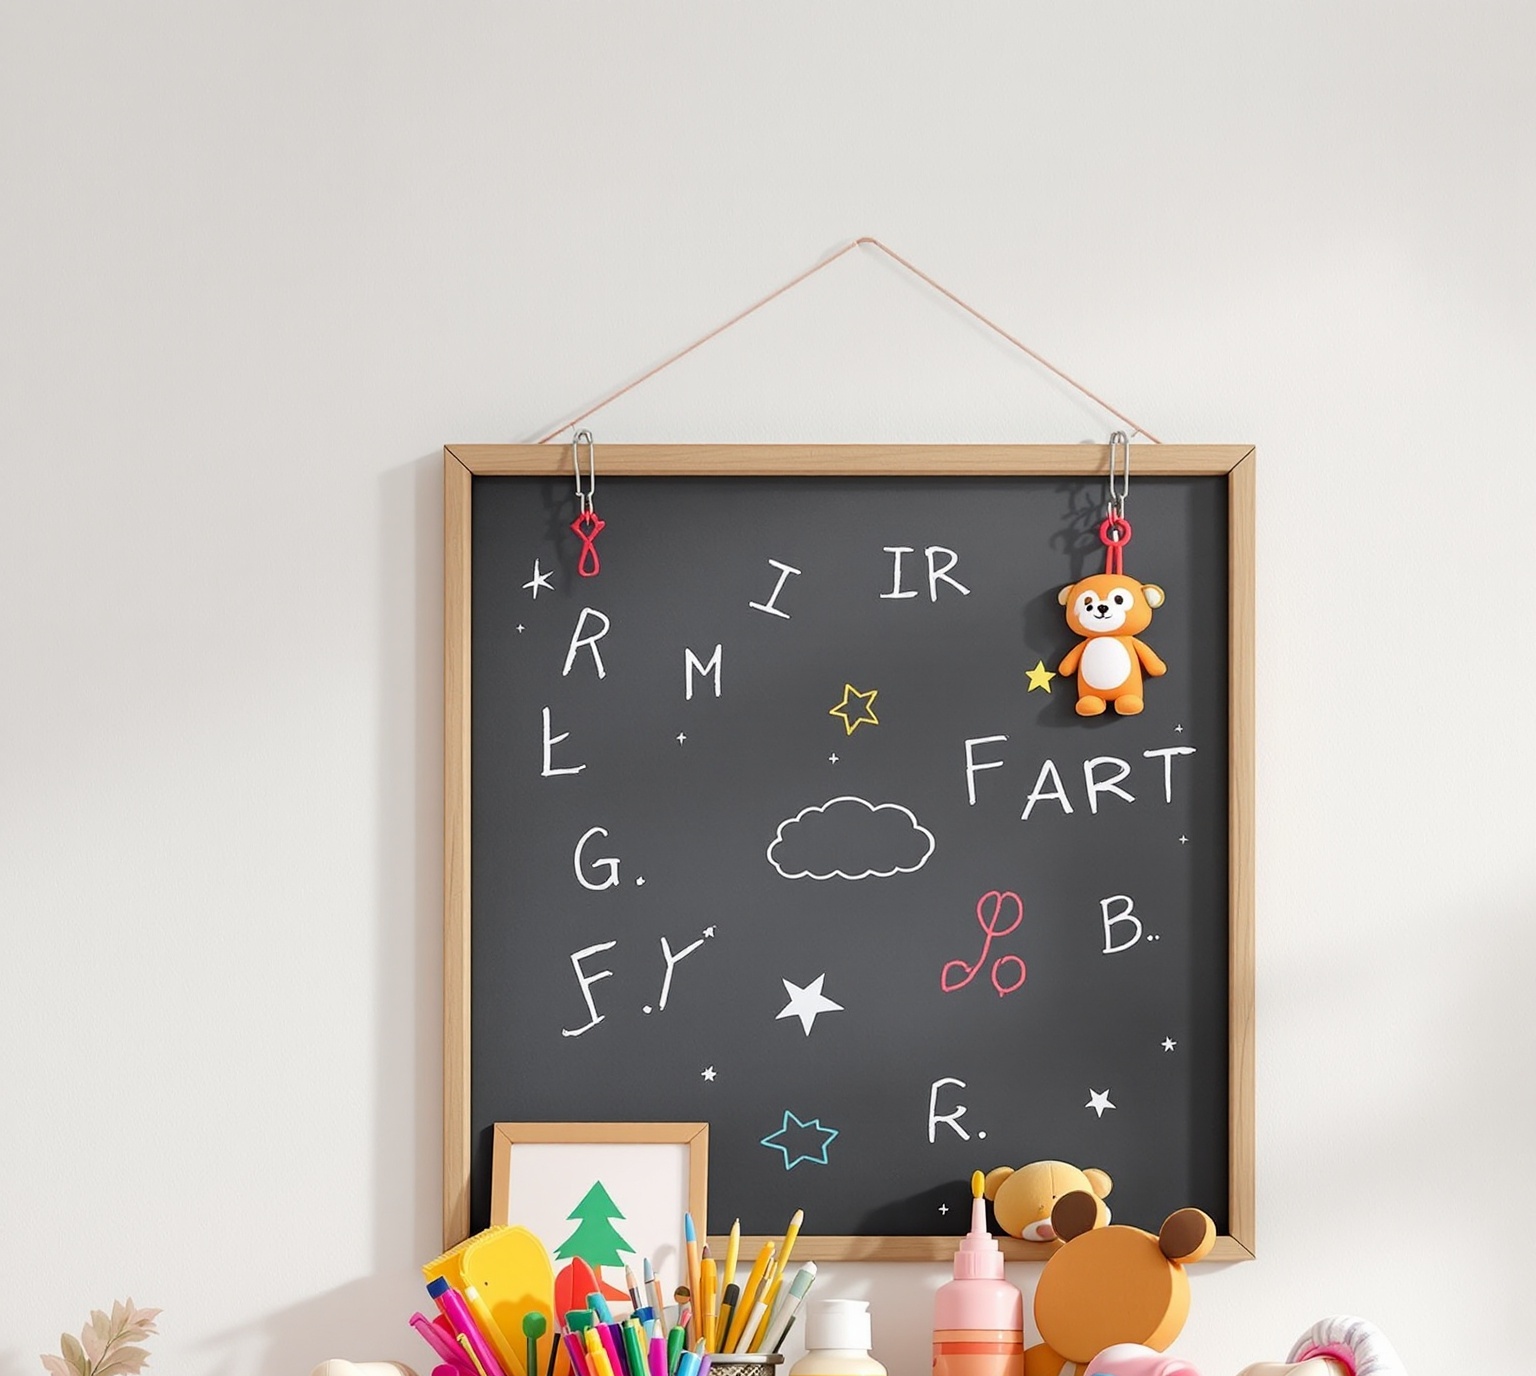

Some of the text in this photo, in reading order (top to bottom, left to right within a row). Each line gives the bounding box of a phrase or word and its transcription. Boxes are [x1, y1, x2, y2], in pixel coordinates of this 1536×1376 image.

[879, 545, 971, 603] IR
[562, 607, 610, 680] R
[684, 643, 723, 701] M
